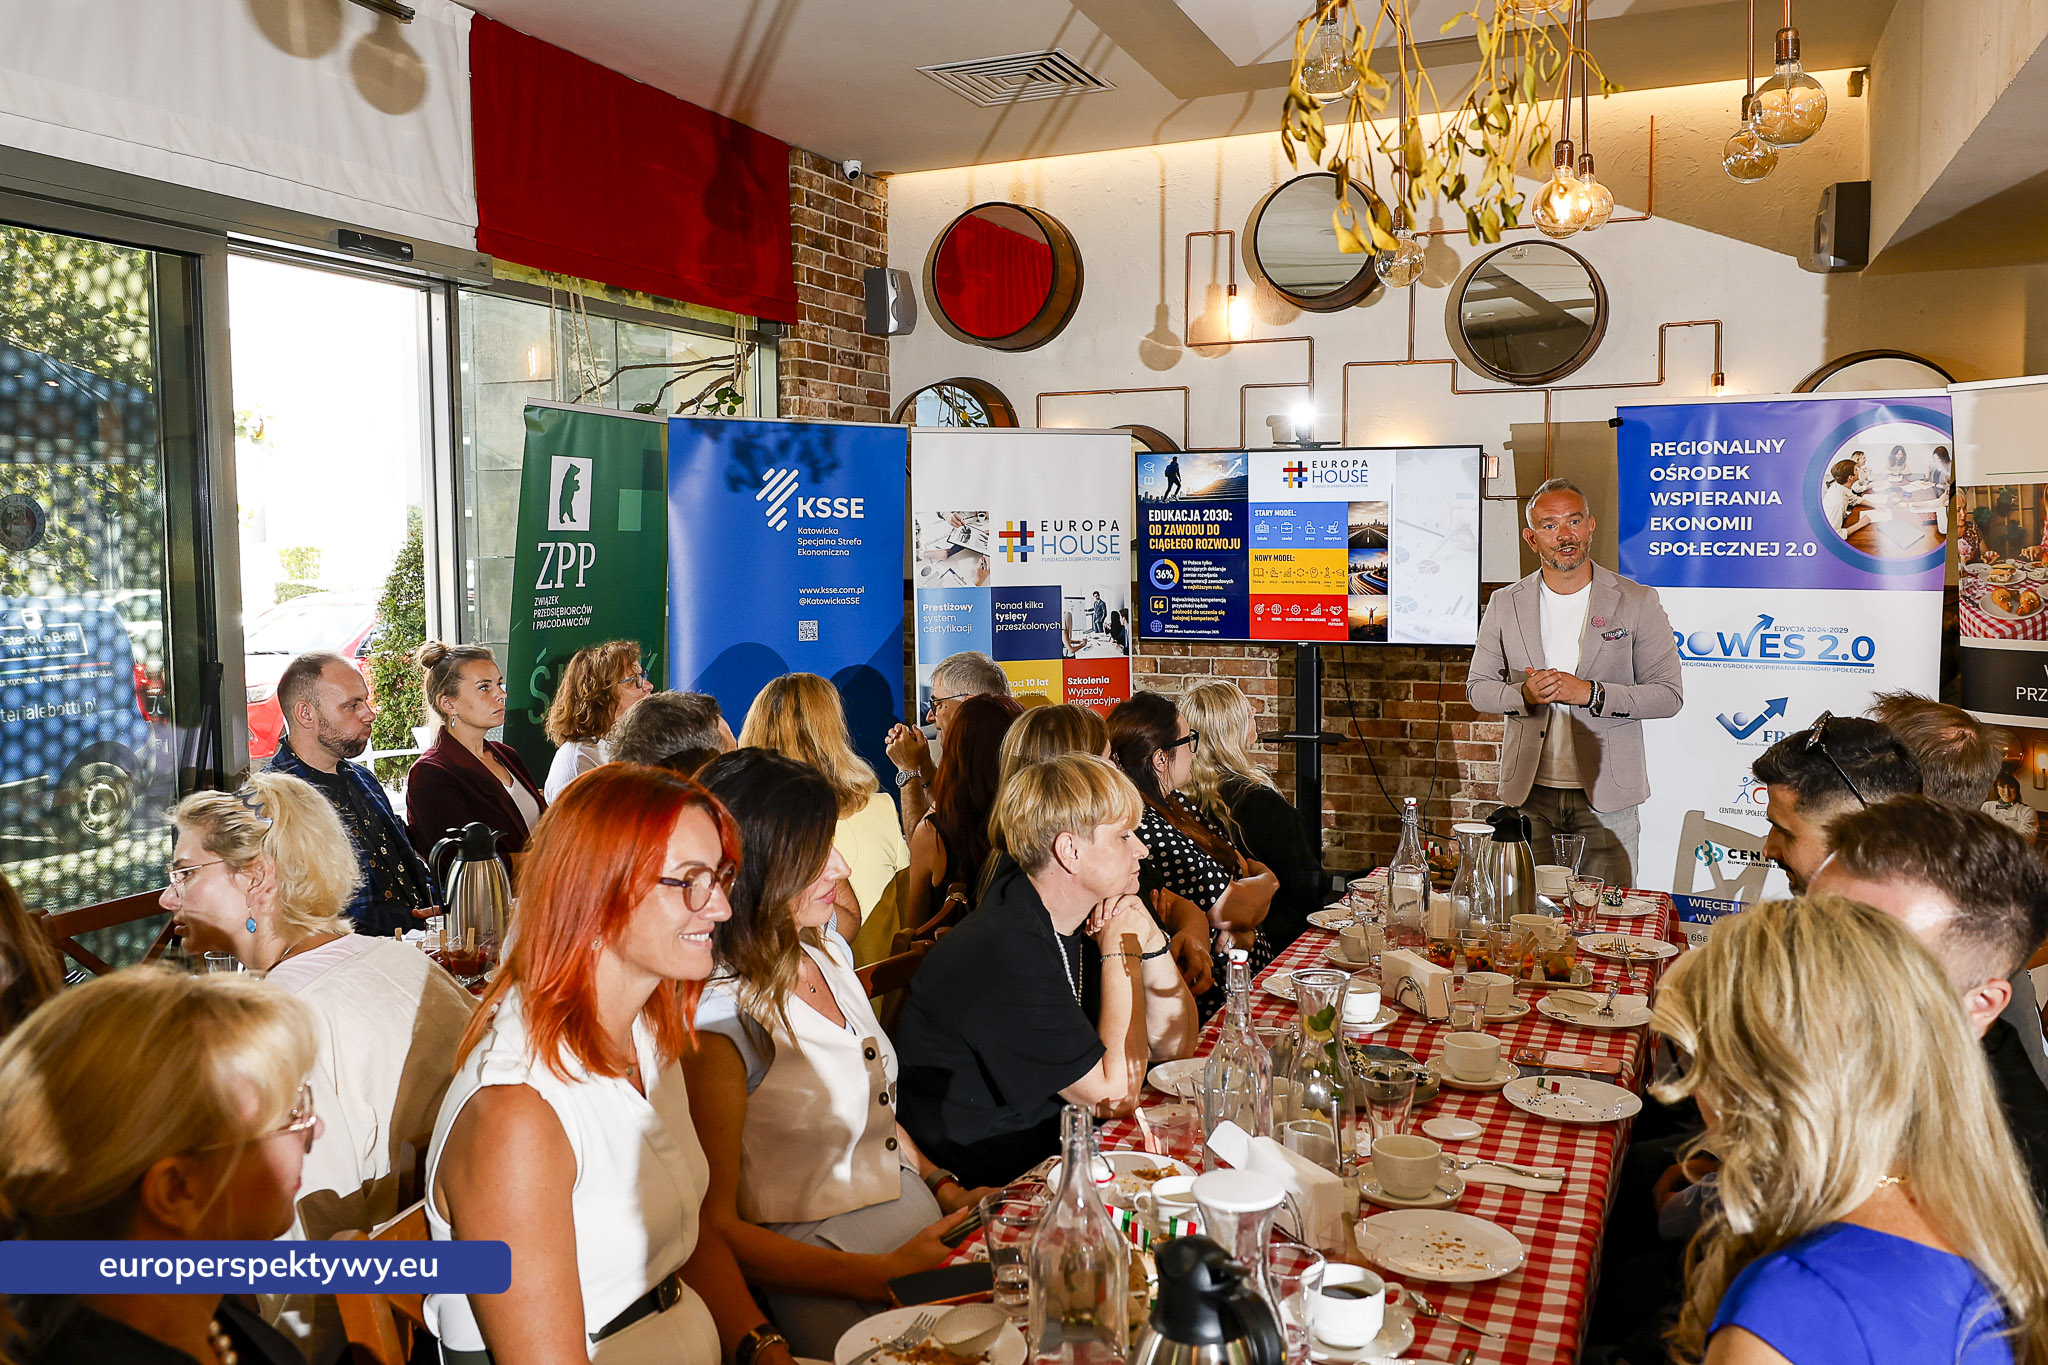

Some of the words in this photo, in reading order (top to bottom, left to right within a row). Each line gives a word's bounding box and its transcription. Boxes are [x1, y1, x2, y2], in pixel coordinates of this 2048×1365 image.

[1650, 438, 1786, 457] REGIONALNY
[1312, 459, 1369, 469] EUROPA
[1312, 469, 1369, 484] HOUSE
[1649, 463, 1751, 481] OŚRODEK
[1649, 490, 1783, 507] WSPIERANIA
[797, 496, 865, 519] KSSE
[1254, 509, 1274, 517] STARY
[1274, 509, 1297, 517] MODEL:
[1148, 509, 1201, 522] EDUKACJA
[1202, 509, 1233, 522] 2030:
[1041, 519, 1120, 532] EUROPA
[1650, 516, 1753, 531] EKONOMII
[797, 526, 839, 535] Katowicka
[1148, 524, 1162, 536] OD
[1164, 523, 1205, 536] ZAWODU
[1206, 524, 1220, 536] DO
[797, 537, 836, 547] Specjalna
[837, 537, 862, 546] Strefa
[1041, 534, 1120, 555] HOUSE
[1149, 538, 1194, 552] CIĄGŁEGO
[1195, 537, 1241, 550] ROZWOJU
[797, 548, 850, 556] Ekonomiczna
[1648, 541, 1781, 557] SPOŁECZNEJ
[1785, 542, 1818, 557] 2.0
[1254, 554, 1272, 562] NOWY
[1273, 554, 1296, 562] MODEL:
[535, 541, 596, 590] ZPP
[1155, 569, 1174, 580] 36%
[798, 585, 865, 595] www.ksse.com.pl
[533, 595, 560, 607] ZWIĄZEK
[798, 596, 861, 606] @KatowickaSSE
[995, 601, 1023, 610] Ponad
[1024, 600, 1044, 609] kilka
[533, 603, 593, 619] PRZEDSIĘBIORCÓW
[922, 602, 974, 613] Prestiżowy
[536, 615, 591, 630] PRACODAWCÓW
[922, 614, 957, 623] system
[995, 612, 1028, 623] tysięcy
[922, 624, 973, 635] certyfikacji
[995, 621, 1061, 633] przeszkolonych
[1774, 625, 1805, 633] EDYCJA
[1807, 626, 1849, 634] 2024-2029
[1817, 634, 1876, 662] 2.0
[1008, 678, 1024, 688] nad
[1025, 678, 1035, 687] 10
[1036, 678, 1049, 686] lat
[1067, 676, 1110, 686] Szkolenia
[1067, 687, 1104, 697] Wyjazdy
[1067, 696, 1121, 707] integracyjne
[1719, 806, 1743, 816] CENTRUM
[1745, 809, 1767, 818] SPOŁECZ
[1688, 898, 1734, 912] WIĘCEJ
[1691, 933, 1708, 943] 696
